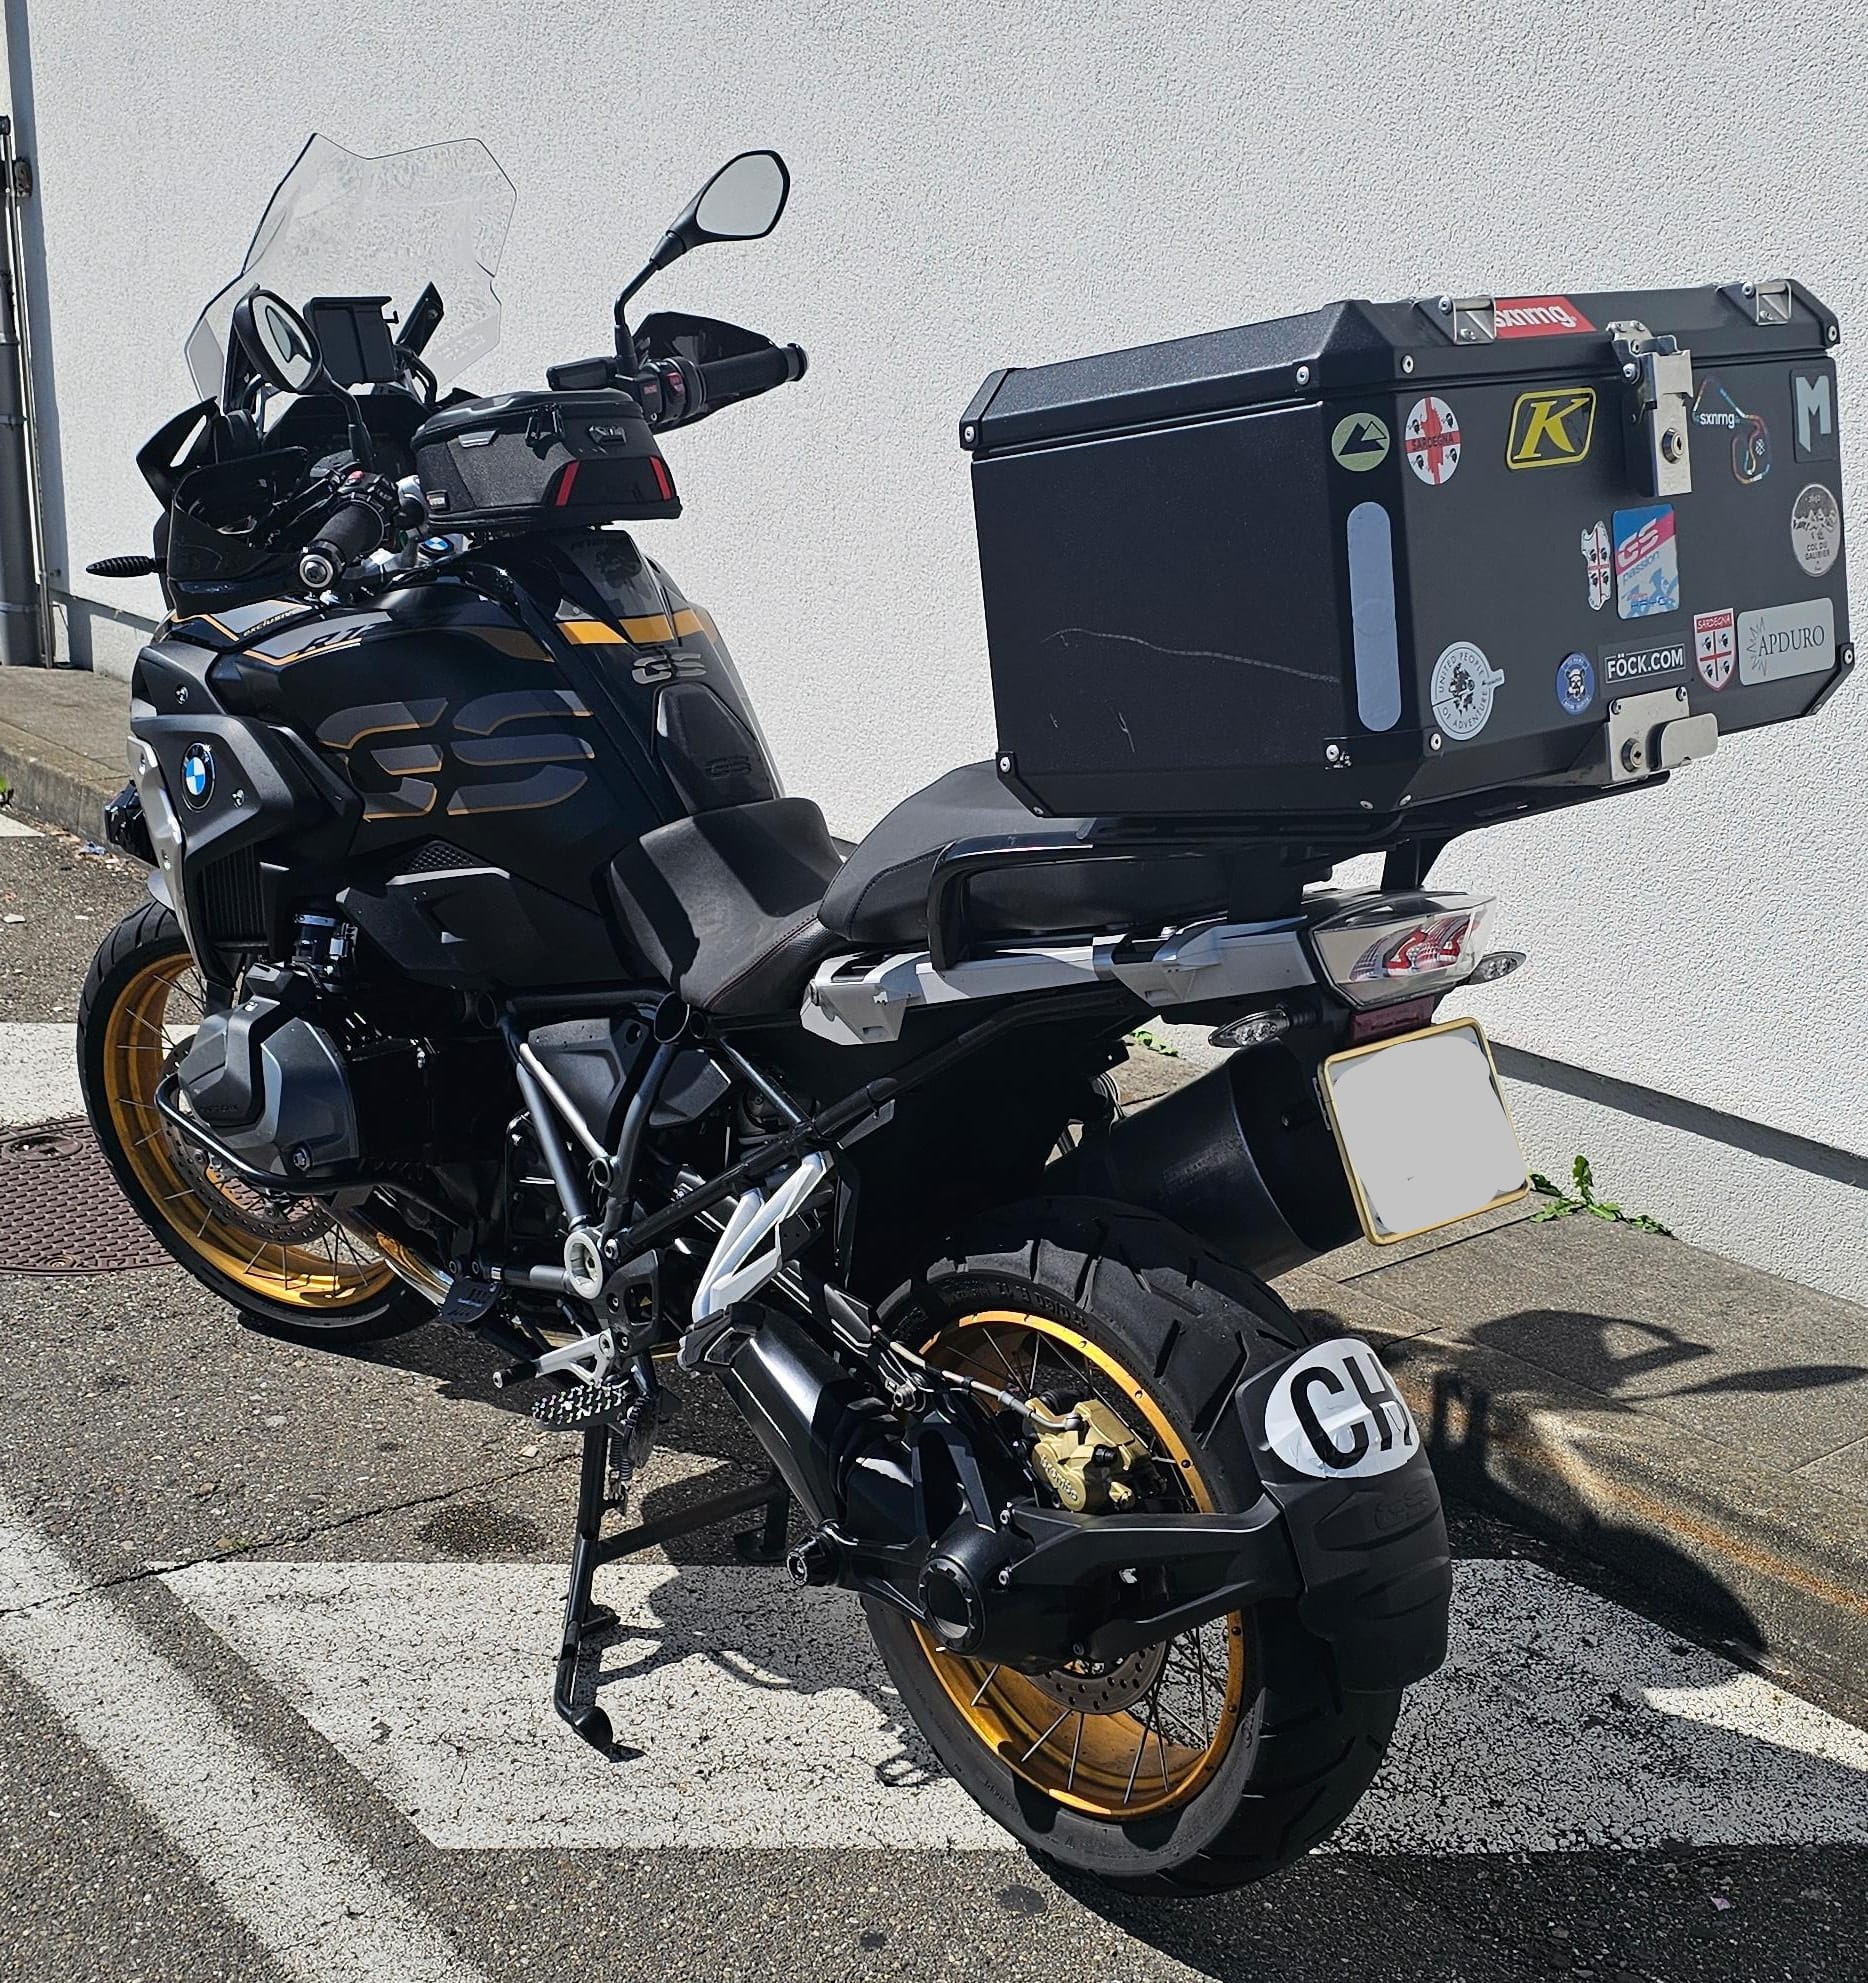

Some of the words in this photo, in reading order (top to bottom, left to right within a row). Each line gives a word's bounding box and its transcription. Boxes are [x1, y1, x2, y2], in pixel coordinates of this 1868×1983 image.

[1513, 397, 1589, 460] K
[1607, 647, 1684, 679] FÖCK.COM
[1758, 625, 1825, 657] APDURO
[1290, 1353, 1412, 1469] CH
